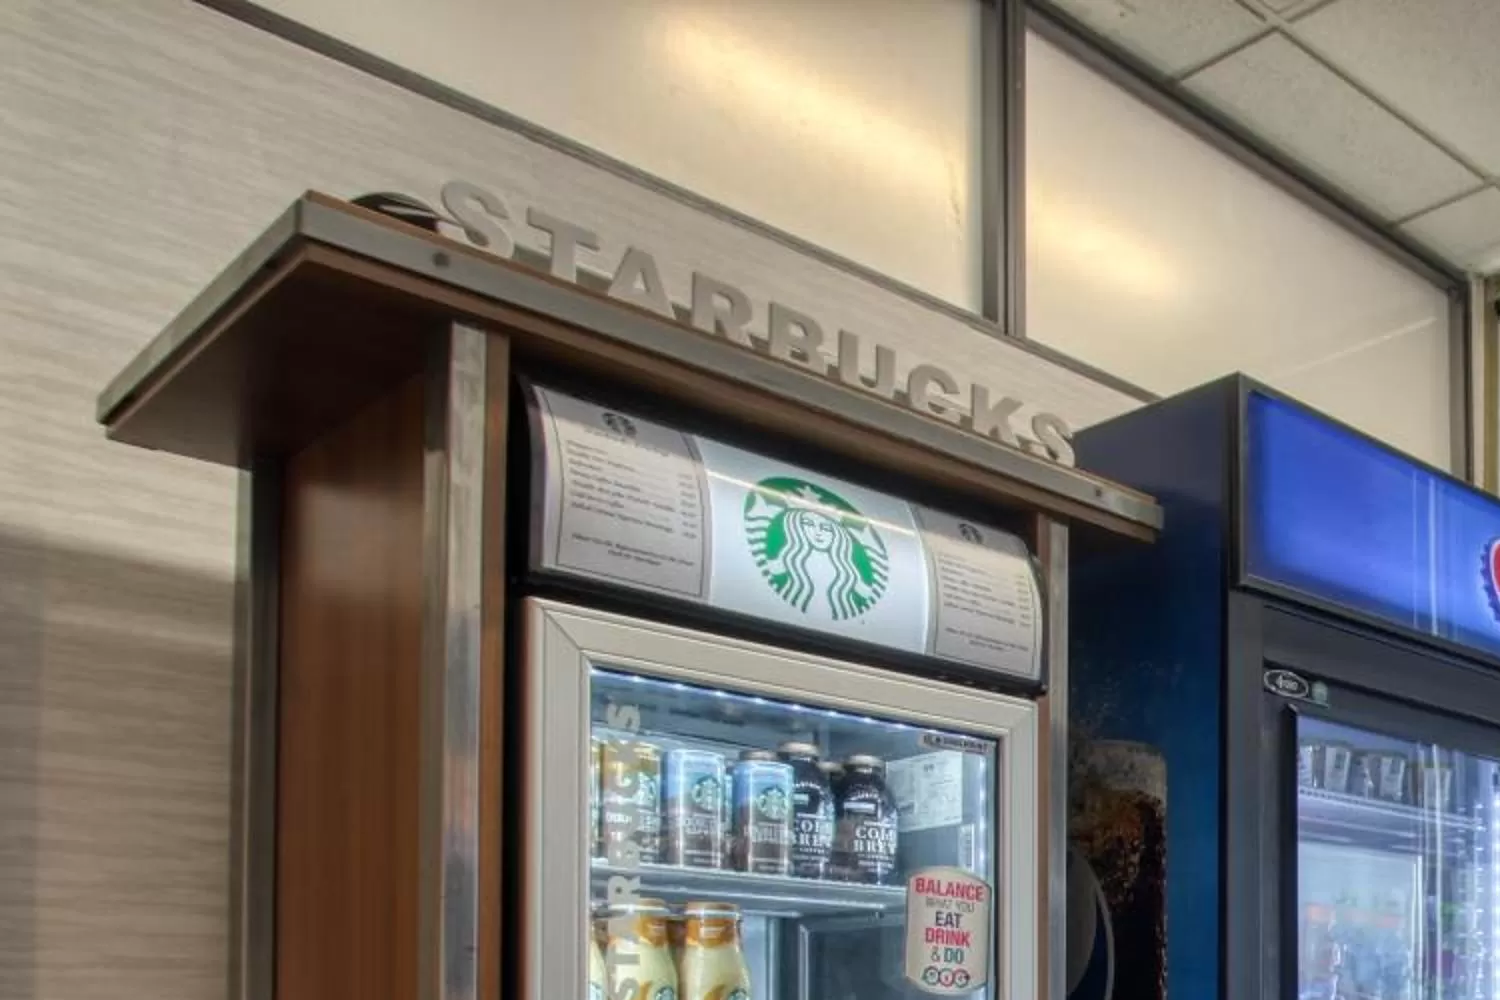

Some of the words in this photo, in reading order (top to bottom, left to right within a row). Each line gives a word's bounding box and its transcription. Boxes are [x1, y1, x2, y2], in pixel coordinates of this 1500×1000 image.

[441, 180, 1075, 467] STARBUCKS
[915, 878, 984, 903] BALANCE
[926, 897, 951, 909] WHAT
[956, 902, 975, 913] YOU
[935, 910, 963, 928] EAT
[925, 928, 971, 948] DRINK
[930, 946, 941, 963] &
[943, 946, 965, 964] DO
